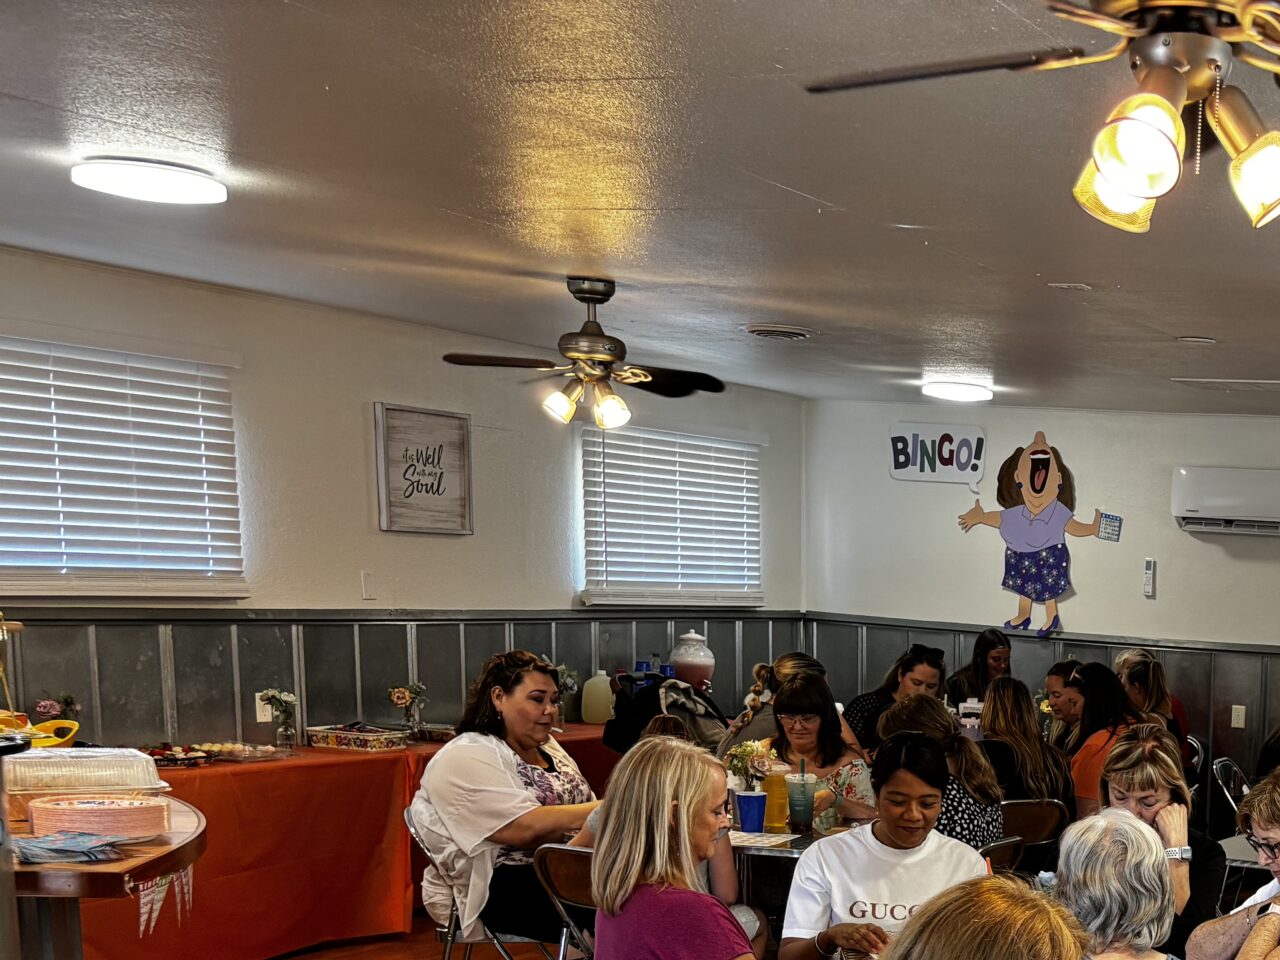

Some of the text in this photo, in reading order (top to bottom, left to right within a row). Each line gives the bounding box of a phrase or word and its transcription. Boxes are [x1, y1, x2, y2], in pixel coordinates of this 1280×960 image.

[416, 444, 443, 469] Well
[891, 433, 984, 472] BINGO!
[403, 463, 446, 499] Soul
